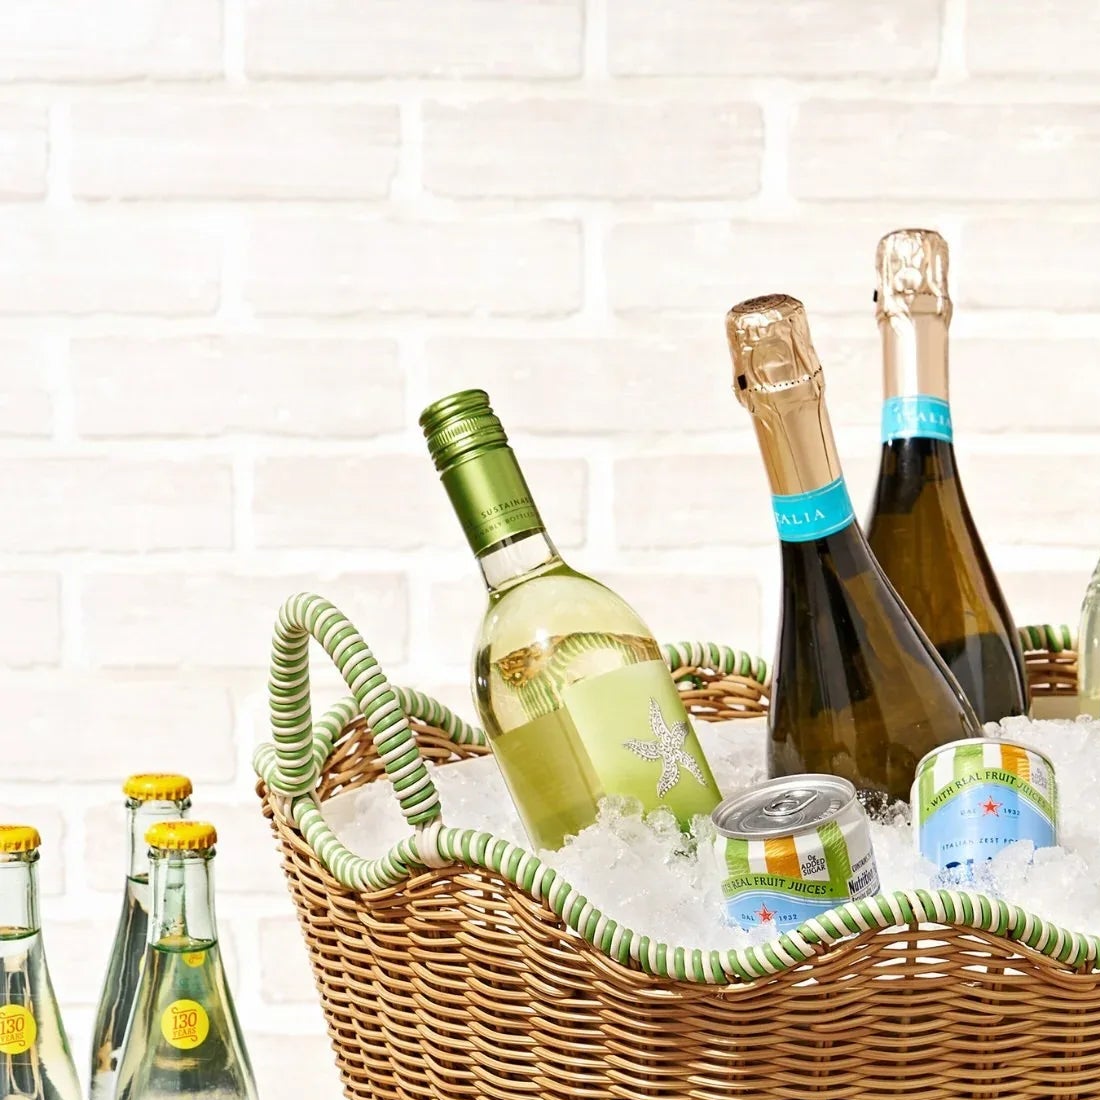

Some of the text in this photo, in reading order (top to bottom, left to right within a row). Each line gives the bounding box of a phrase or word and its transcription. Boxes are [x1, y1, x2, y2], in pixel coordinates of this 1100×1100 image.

[930, 786, 955, 807] WITH
[954, 772, 983, 789] REAL
[985, 771, 1017, 785] FRUIT
[1003, 807, 1021, 817] 1932
[800, 857, 826, 871] ADDED
[802, 864, 827, 877] SUGAR
[732, 877, 753, 891] REAL
[753, 876, 787, 888] FRUIT
[787, 881, 828, 895] JUICES
[778, 913, 799, 922] 1932
[0, 1016, 25, 1035] 130
[172, 1011, 198, 1030] 130
[172, 1027, 197, 1038] YEARS
